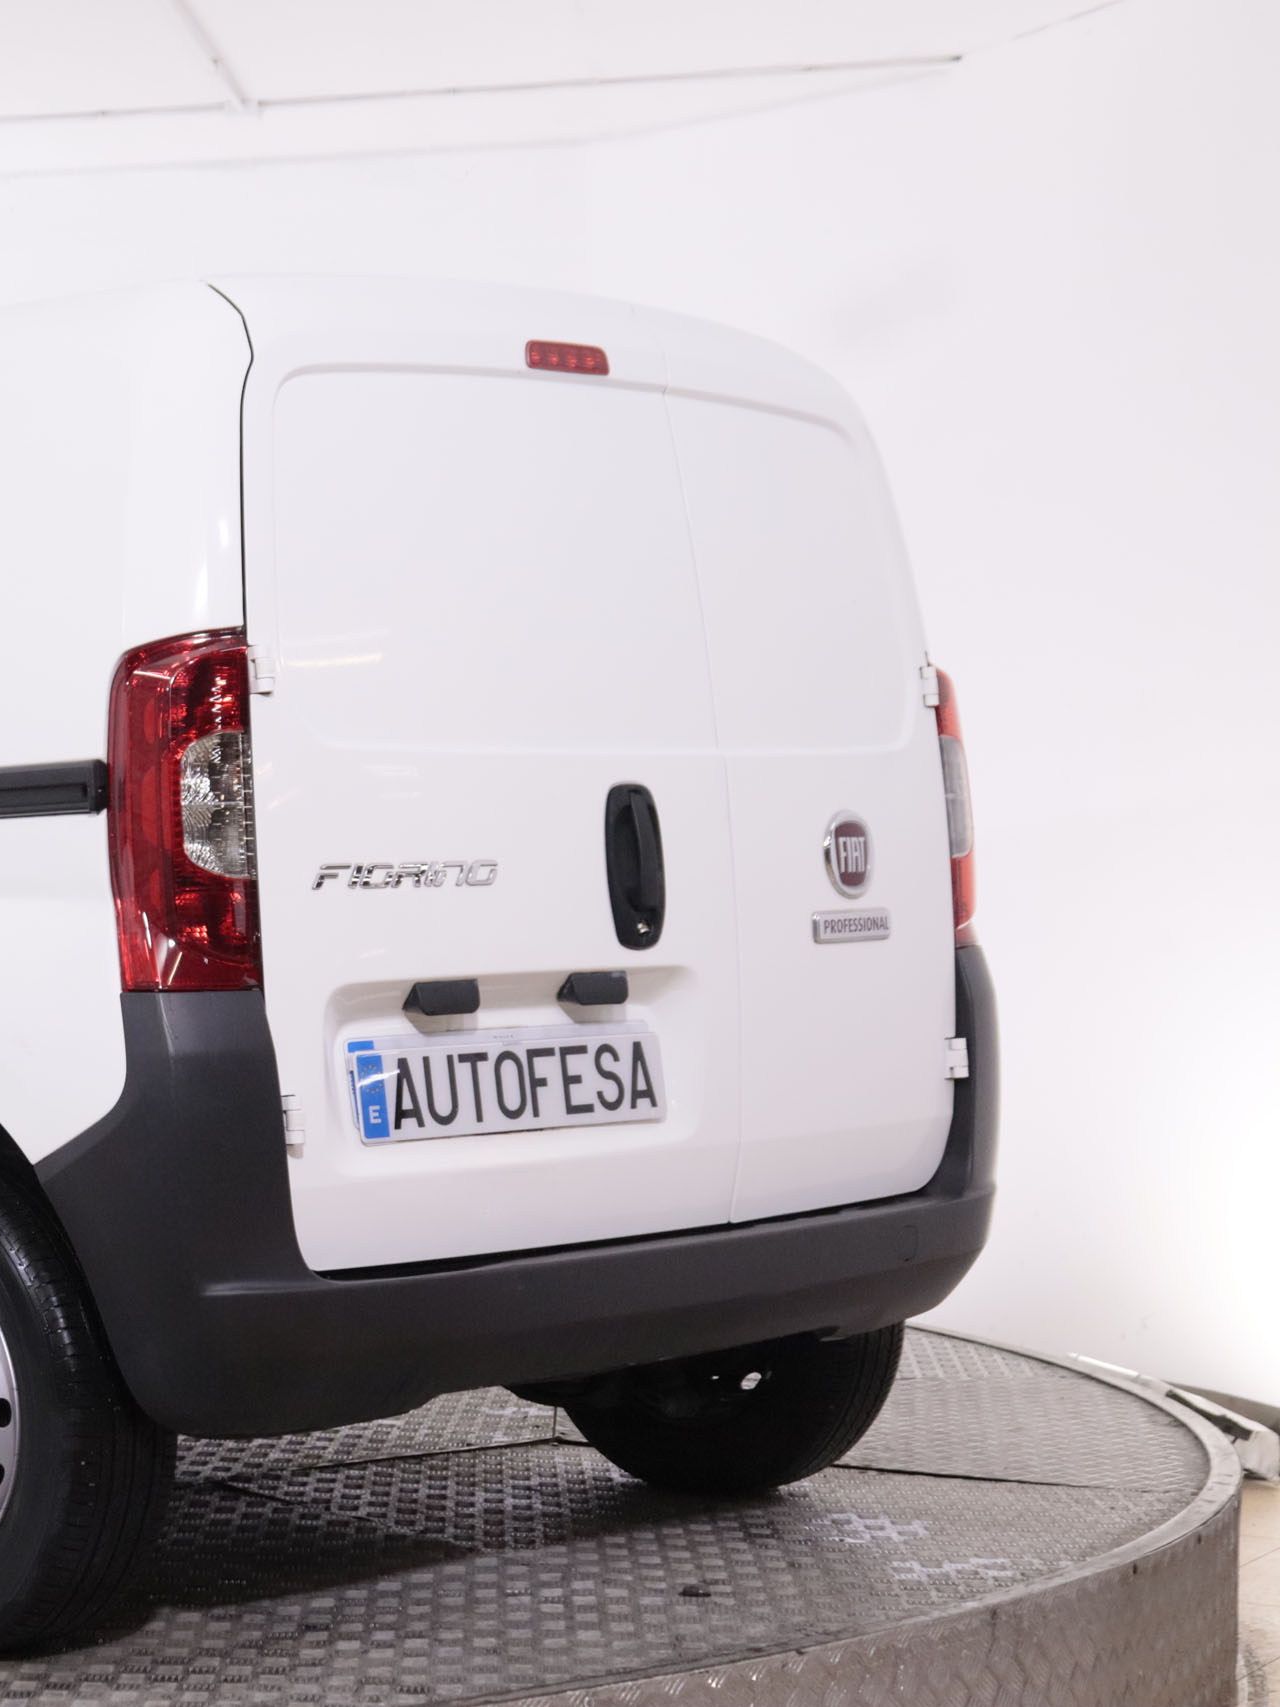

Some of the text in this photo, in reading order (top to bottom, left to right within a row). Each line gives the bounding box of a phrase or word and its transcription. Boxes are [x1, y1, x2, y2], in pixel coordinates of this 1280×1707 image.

[838, 836, 865, 873] FIAT
[311, 860, 498, 890] FIORINO
[823, 916, 889, 935] PROFESSIONAL
[393, 1041, 658, 1130] AUTOFESA
[368, 1105, 382, 1124] E
